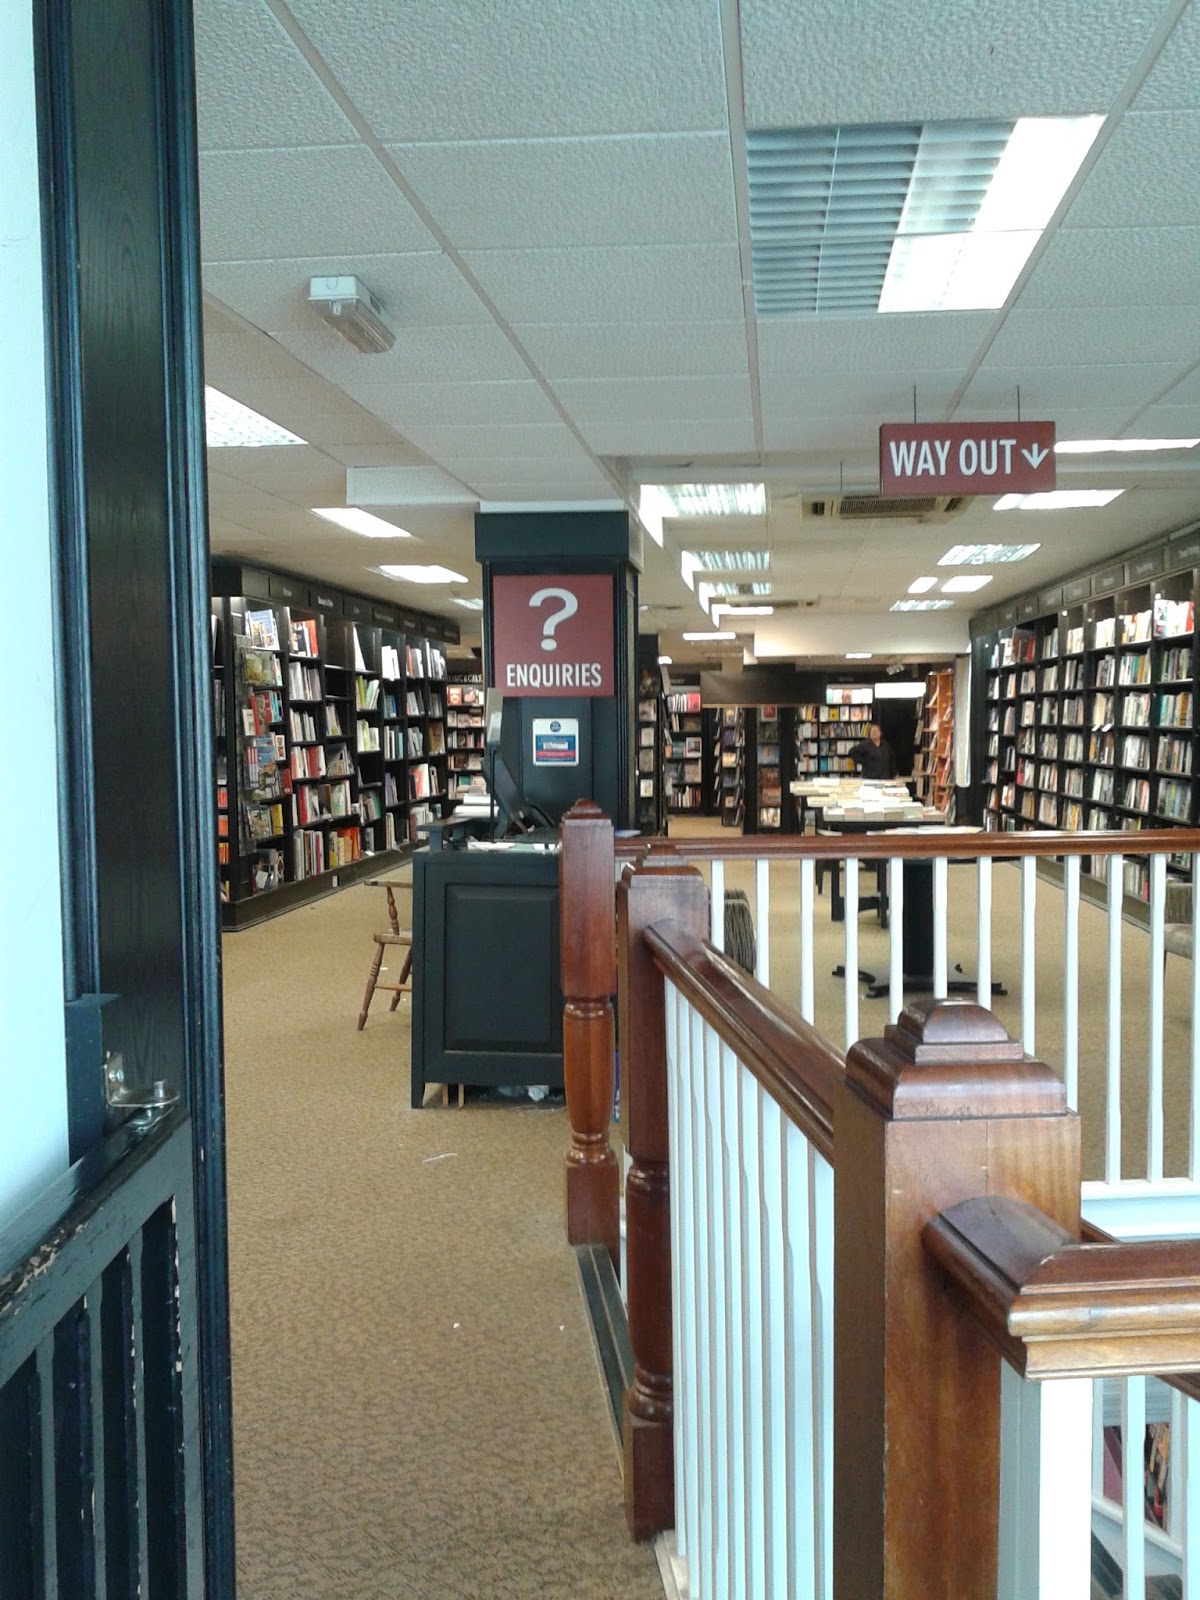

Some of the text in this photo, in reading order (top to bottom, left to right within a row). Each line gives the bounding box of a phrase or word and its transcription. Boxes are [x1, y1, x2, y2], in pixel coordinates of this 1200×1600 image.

[889, 438, 1017, 477] WAY OUT
[528, 587, 579, 651] ?
[506, 663, 602, 688] ENQUIRIES
